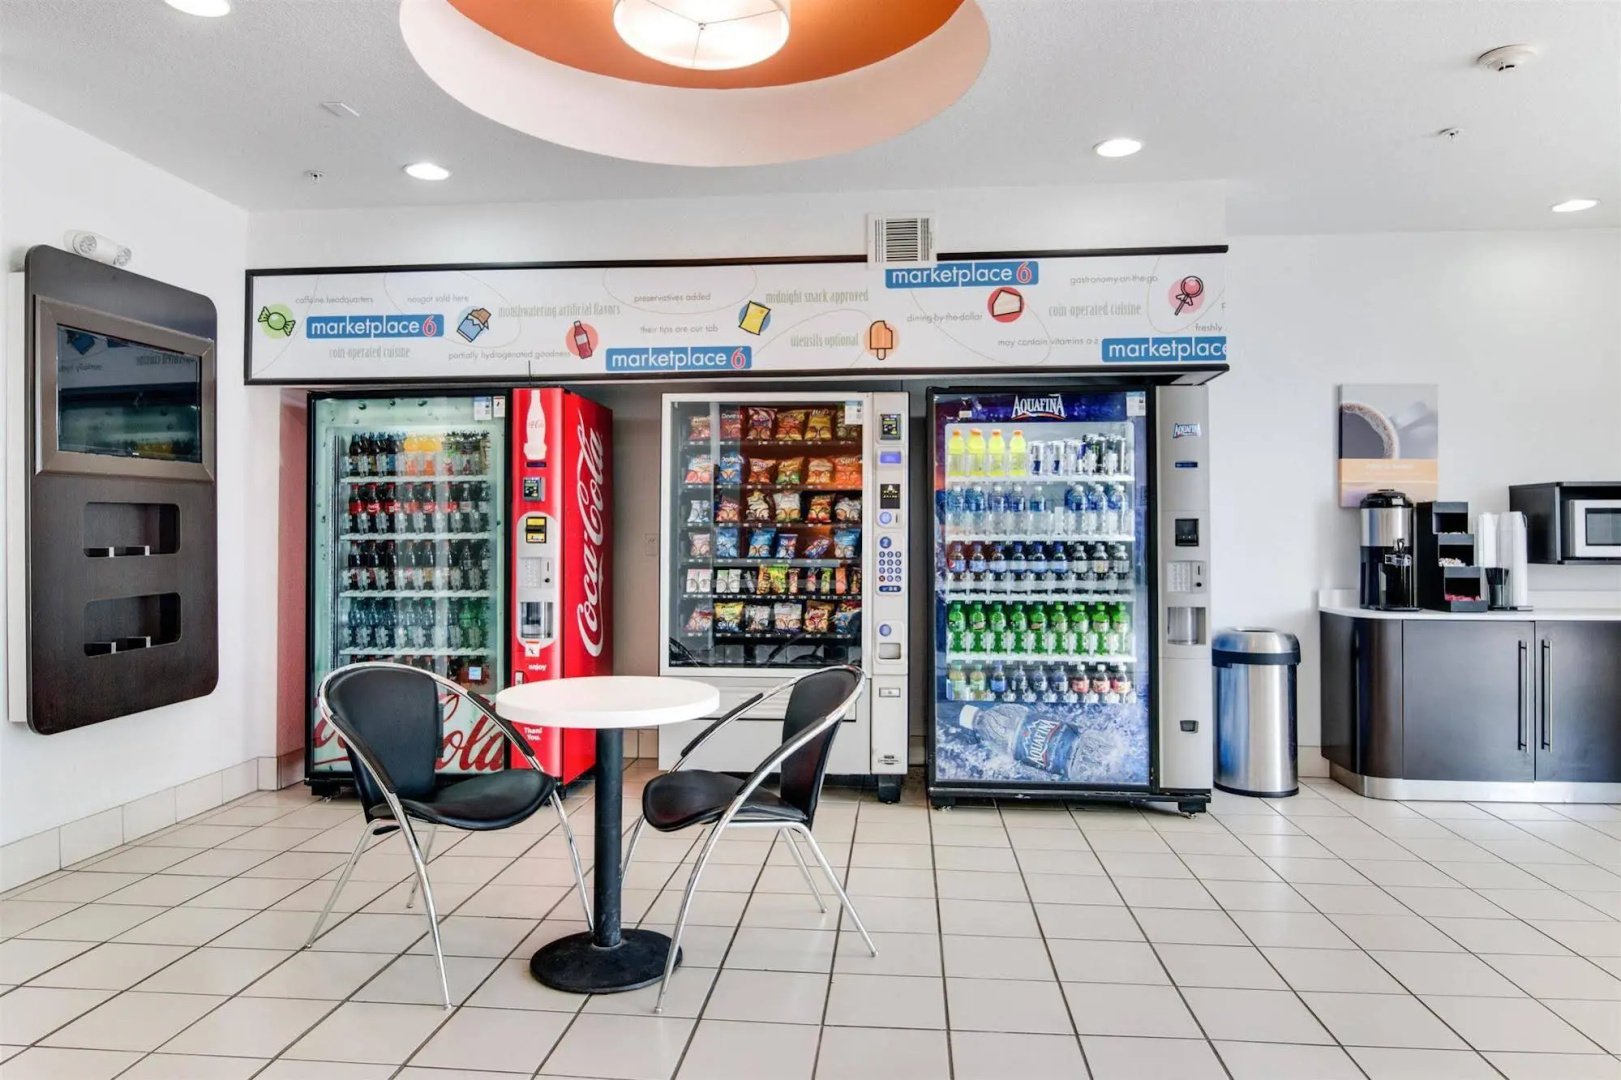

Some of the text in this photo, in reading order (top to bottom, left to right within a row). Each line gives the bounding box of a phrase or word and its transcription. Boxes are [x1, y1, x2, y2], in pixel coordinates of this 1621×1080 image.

[892, 261, 1032, 287] marketplace 6
[435, 293, 451, 302] sold
[452, 293, 469, 302] here
[634, 291, 712, 303] preservatives added
[765, 287, 869, 305] midnight snack approved
[498, 300, 622, 319] mouthwatering artificial flavors
[1110, 301, 1142, 316] cuisine
[311, 314, 437, 338] marketplace 6
[640, 324, 658, 334] their
[659, 325, 673, 335] tips
[674, 326, 688, 334] are
[705, 324, 719, 333] tab
[1195, 322, 1223, 333] freshly
[790, 332, 859, 348] utensils optional
[998, 339, 1015, 348] may
[1017, 337, 1048, 347] contain
[1050, 337, 1084, 345] vitamins
[383, 344, 411, 358] cuisine
[448, 348, 571, 361] partially hydrogenated goodness
[612, 347, 746, 371] marketplace 6
[1011, 394, 1066, 419] AQUAFINA
[576, 408, 604, 658] Coca-Cola
[528, 664, 547, 672] enjoy
